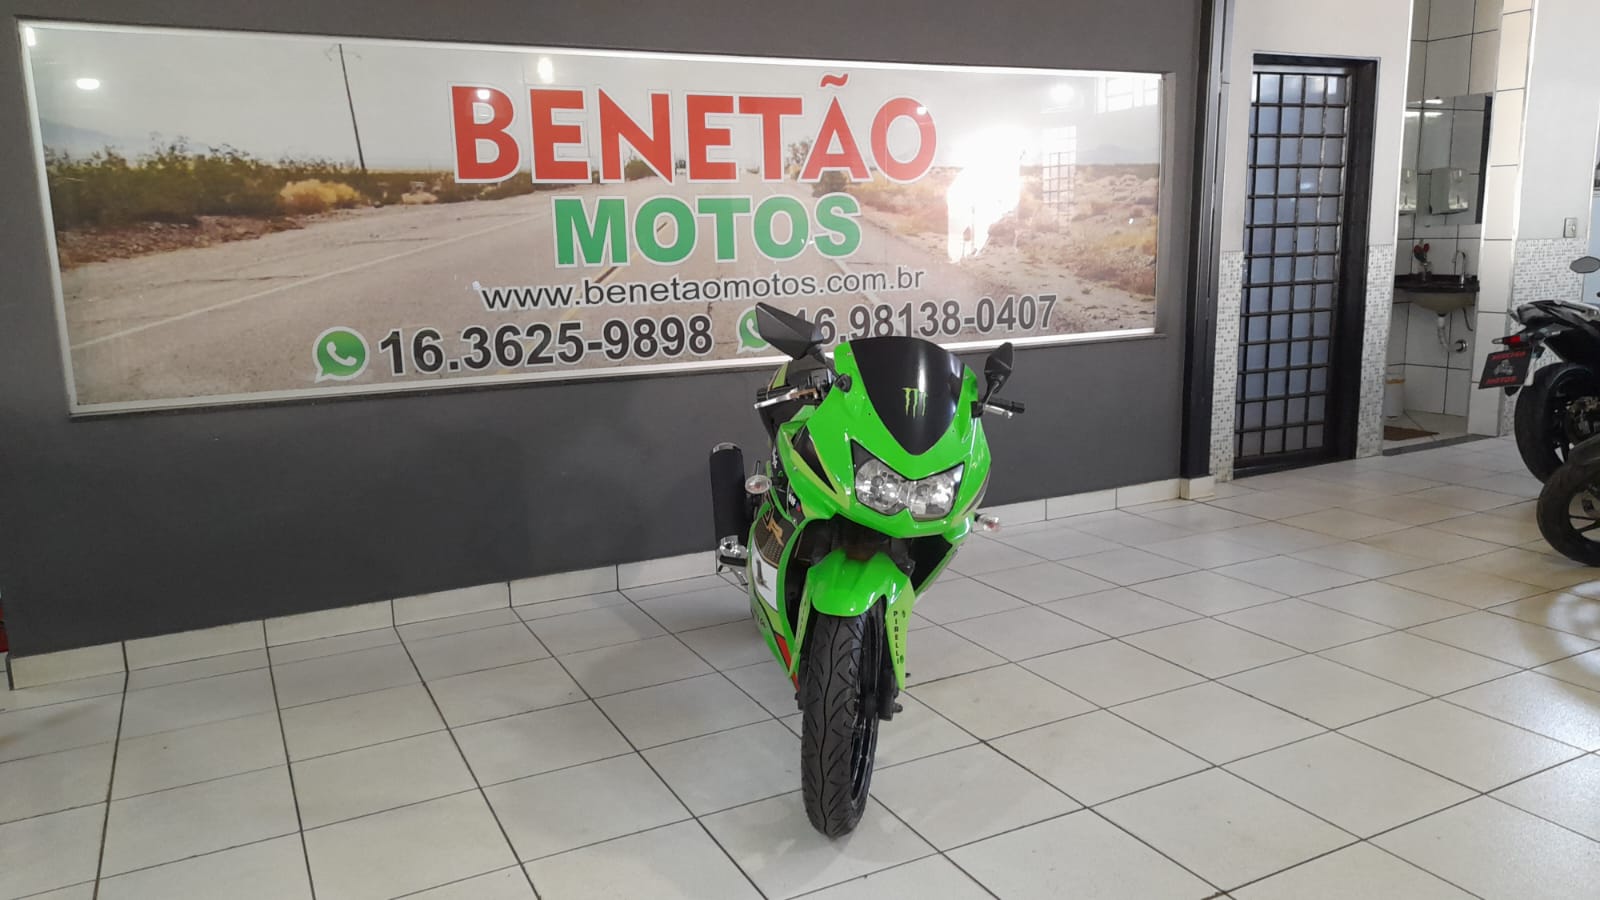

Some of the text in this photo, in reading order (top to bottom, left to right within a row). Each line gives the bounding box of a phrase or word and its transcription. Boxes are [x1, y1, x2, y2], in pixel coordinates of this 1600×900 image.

[451, 73, 937, 183] BENETÃO
[555, 196, 861, 265] MOTOS
[482, 266, 925, 310] www.benetaomotos.com.br
[379, 315, 713, 374] 16.3625-9898
